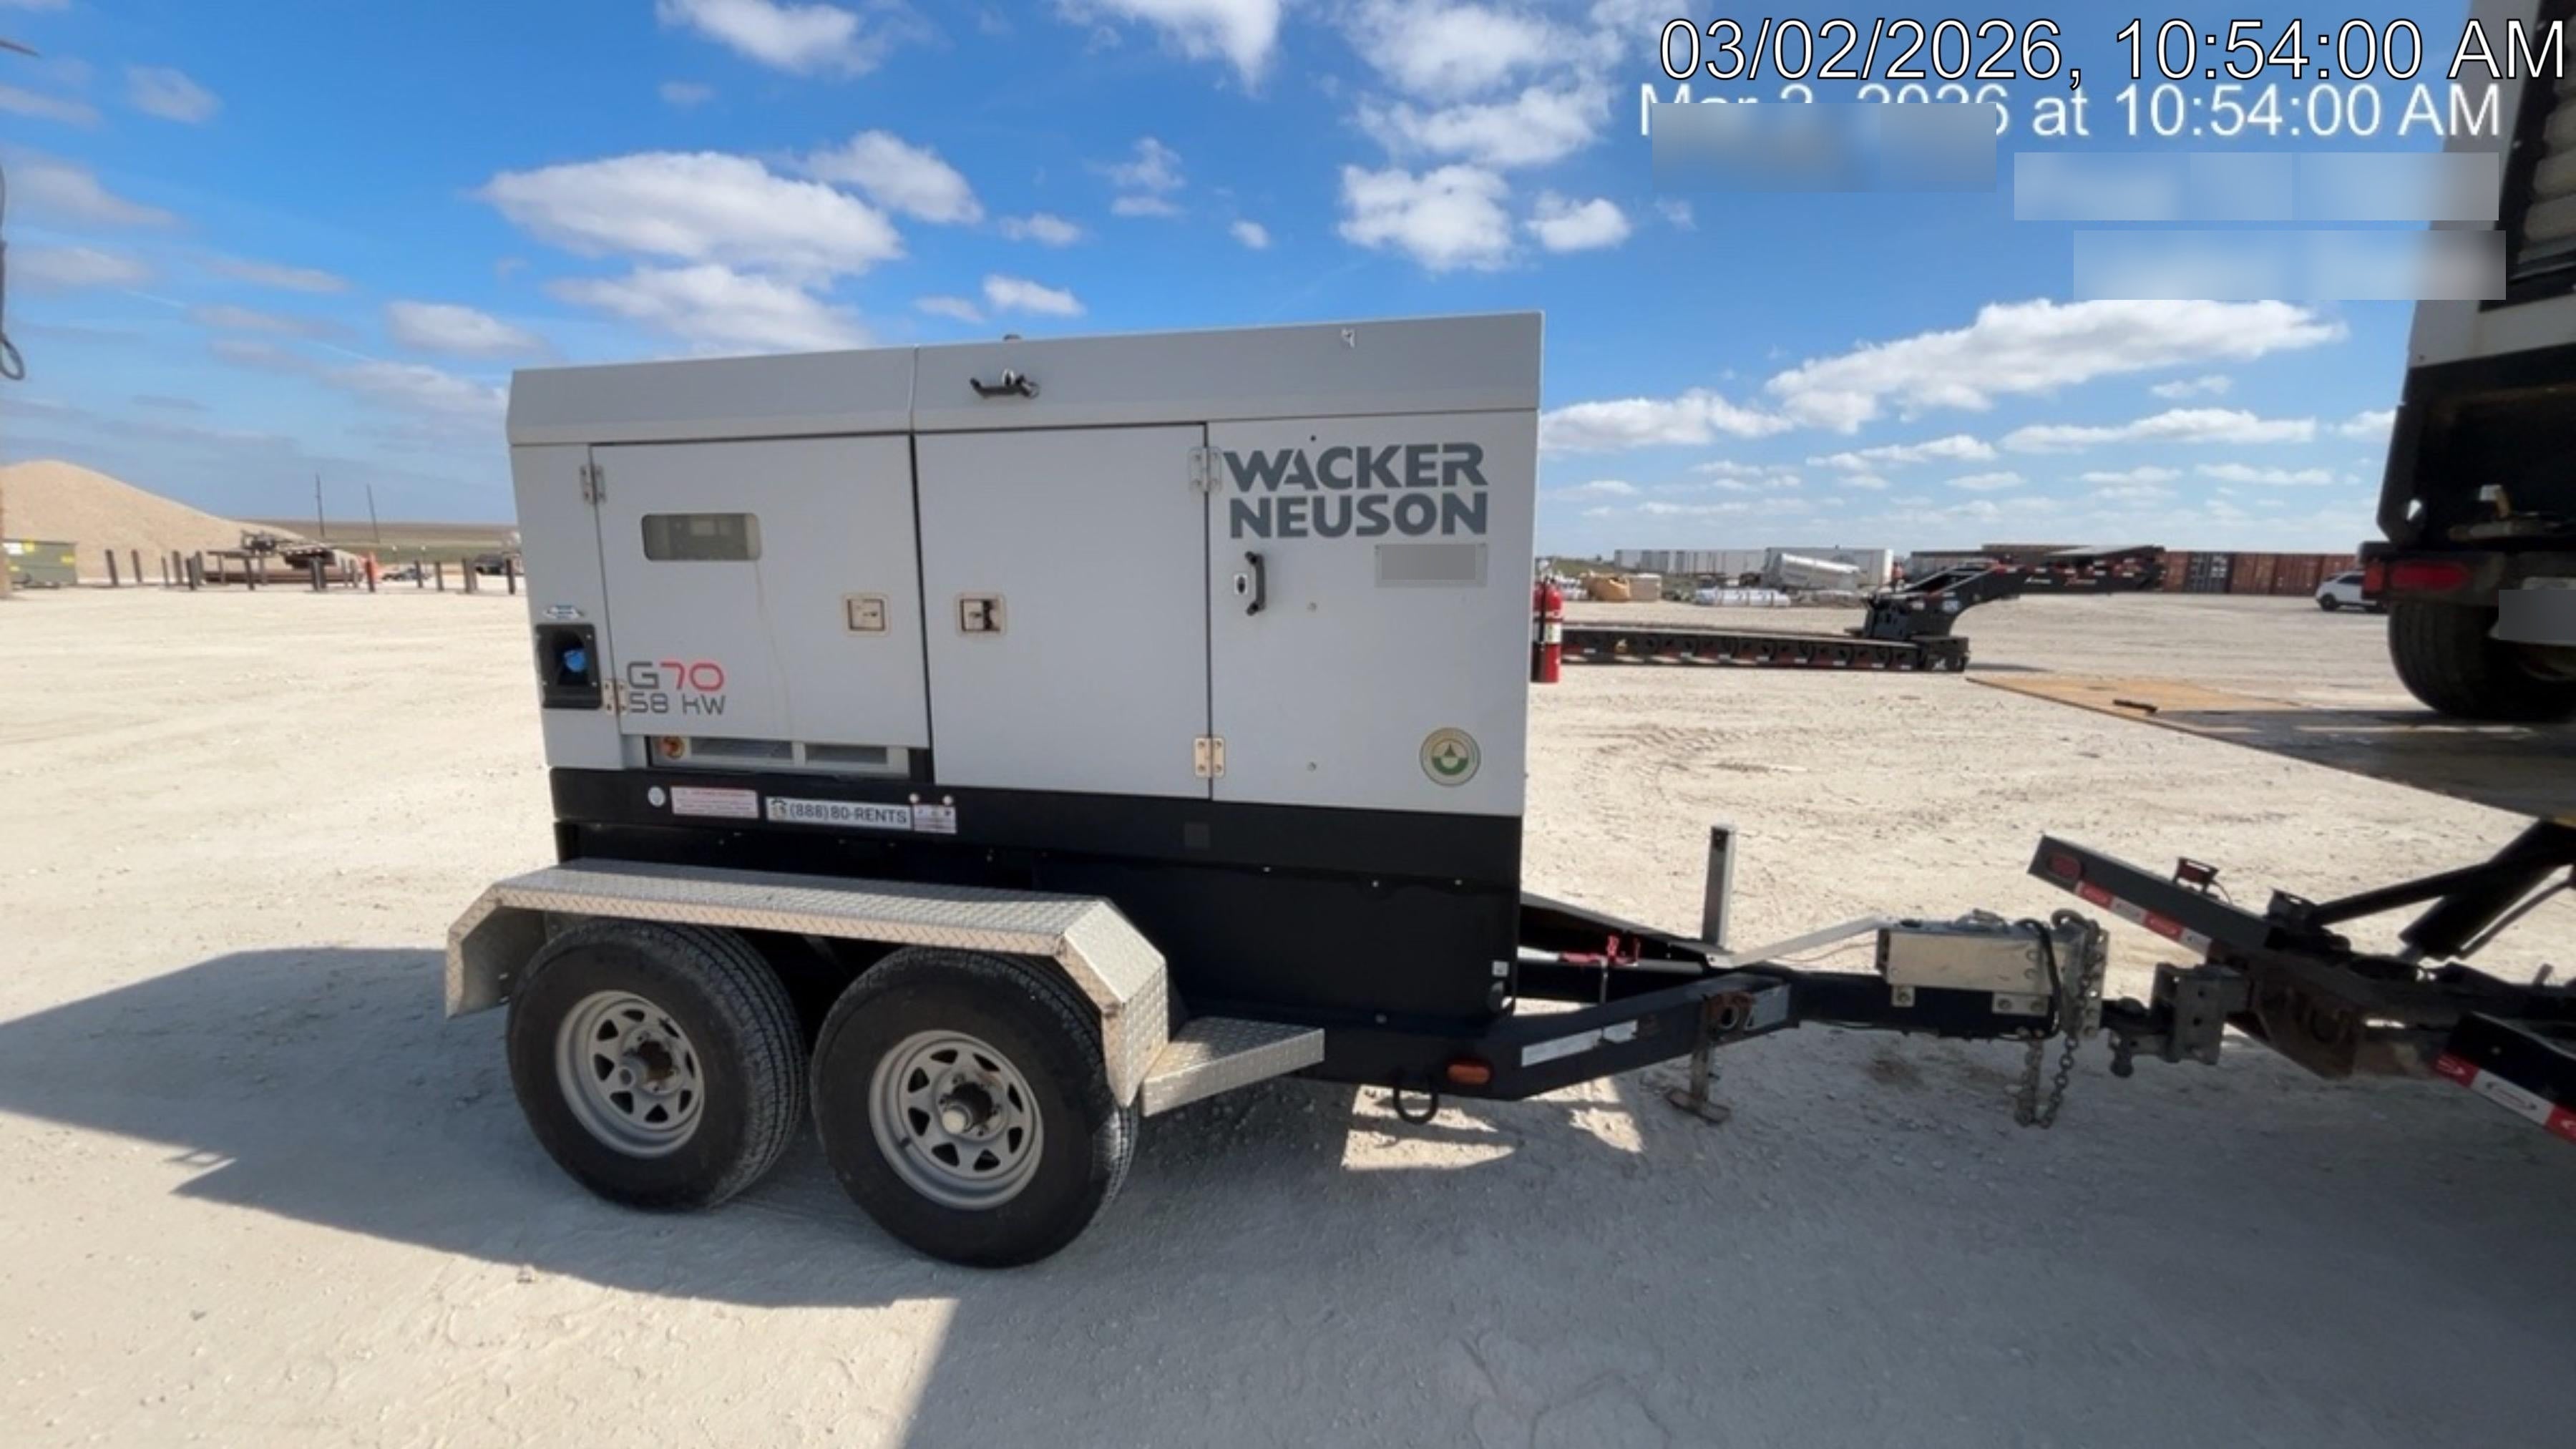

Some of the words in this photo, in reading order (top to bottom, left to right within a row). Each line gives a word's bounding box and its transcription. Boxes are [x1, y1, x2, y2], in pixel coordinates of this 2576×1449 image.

[1223, 442, 1489, 492] WACKER
[1230, 492, 1488, 538] NEUSON
[627, 660, 724, 691] G70
[630, 692, 669, 713] 58
